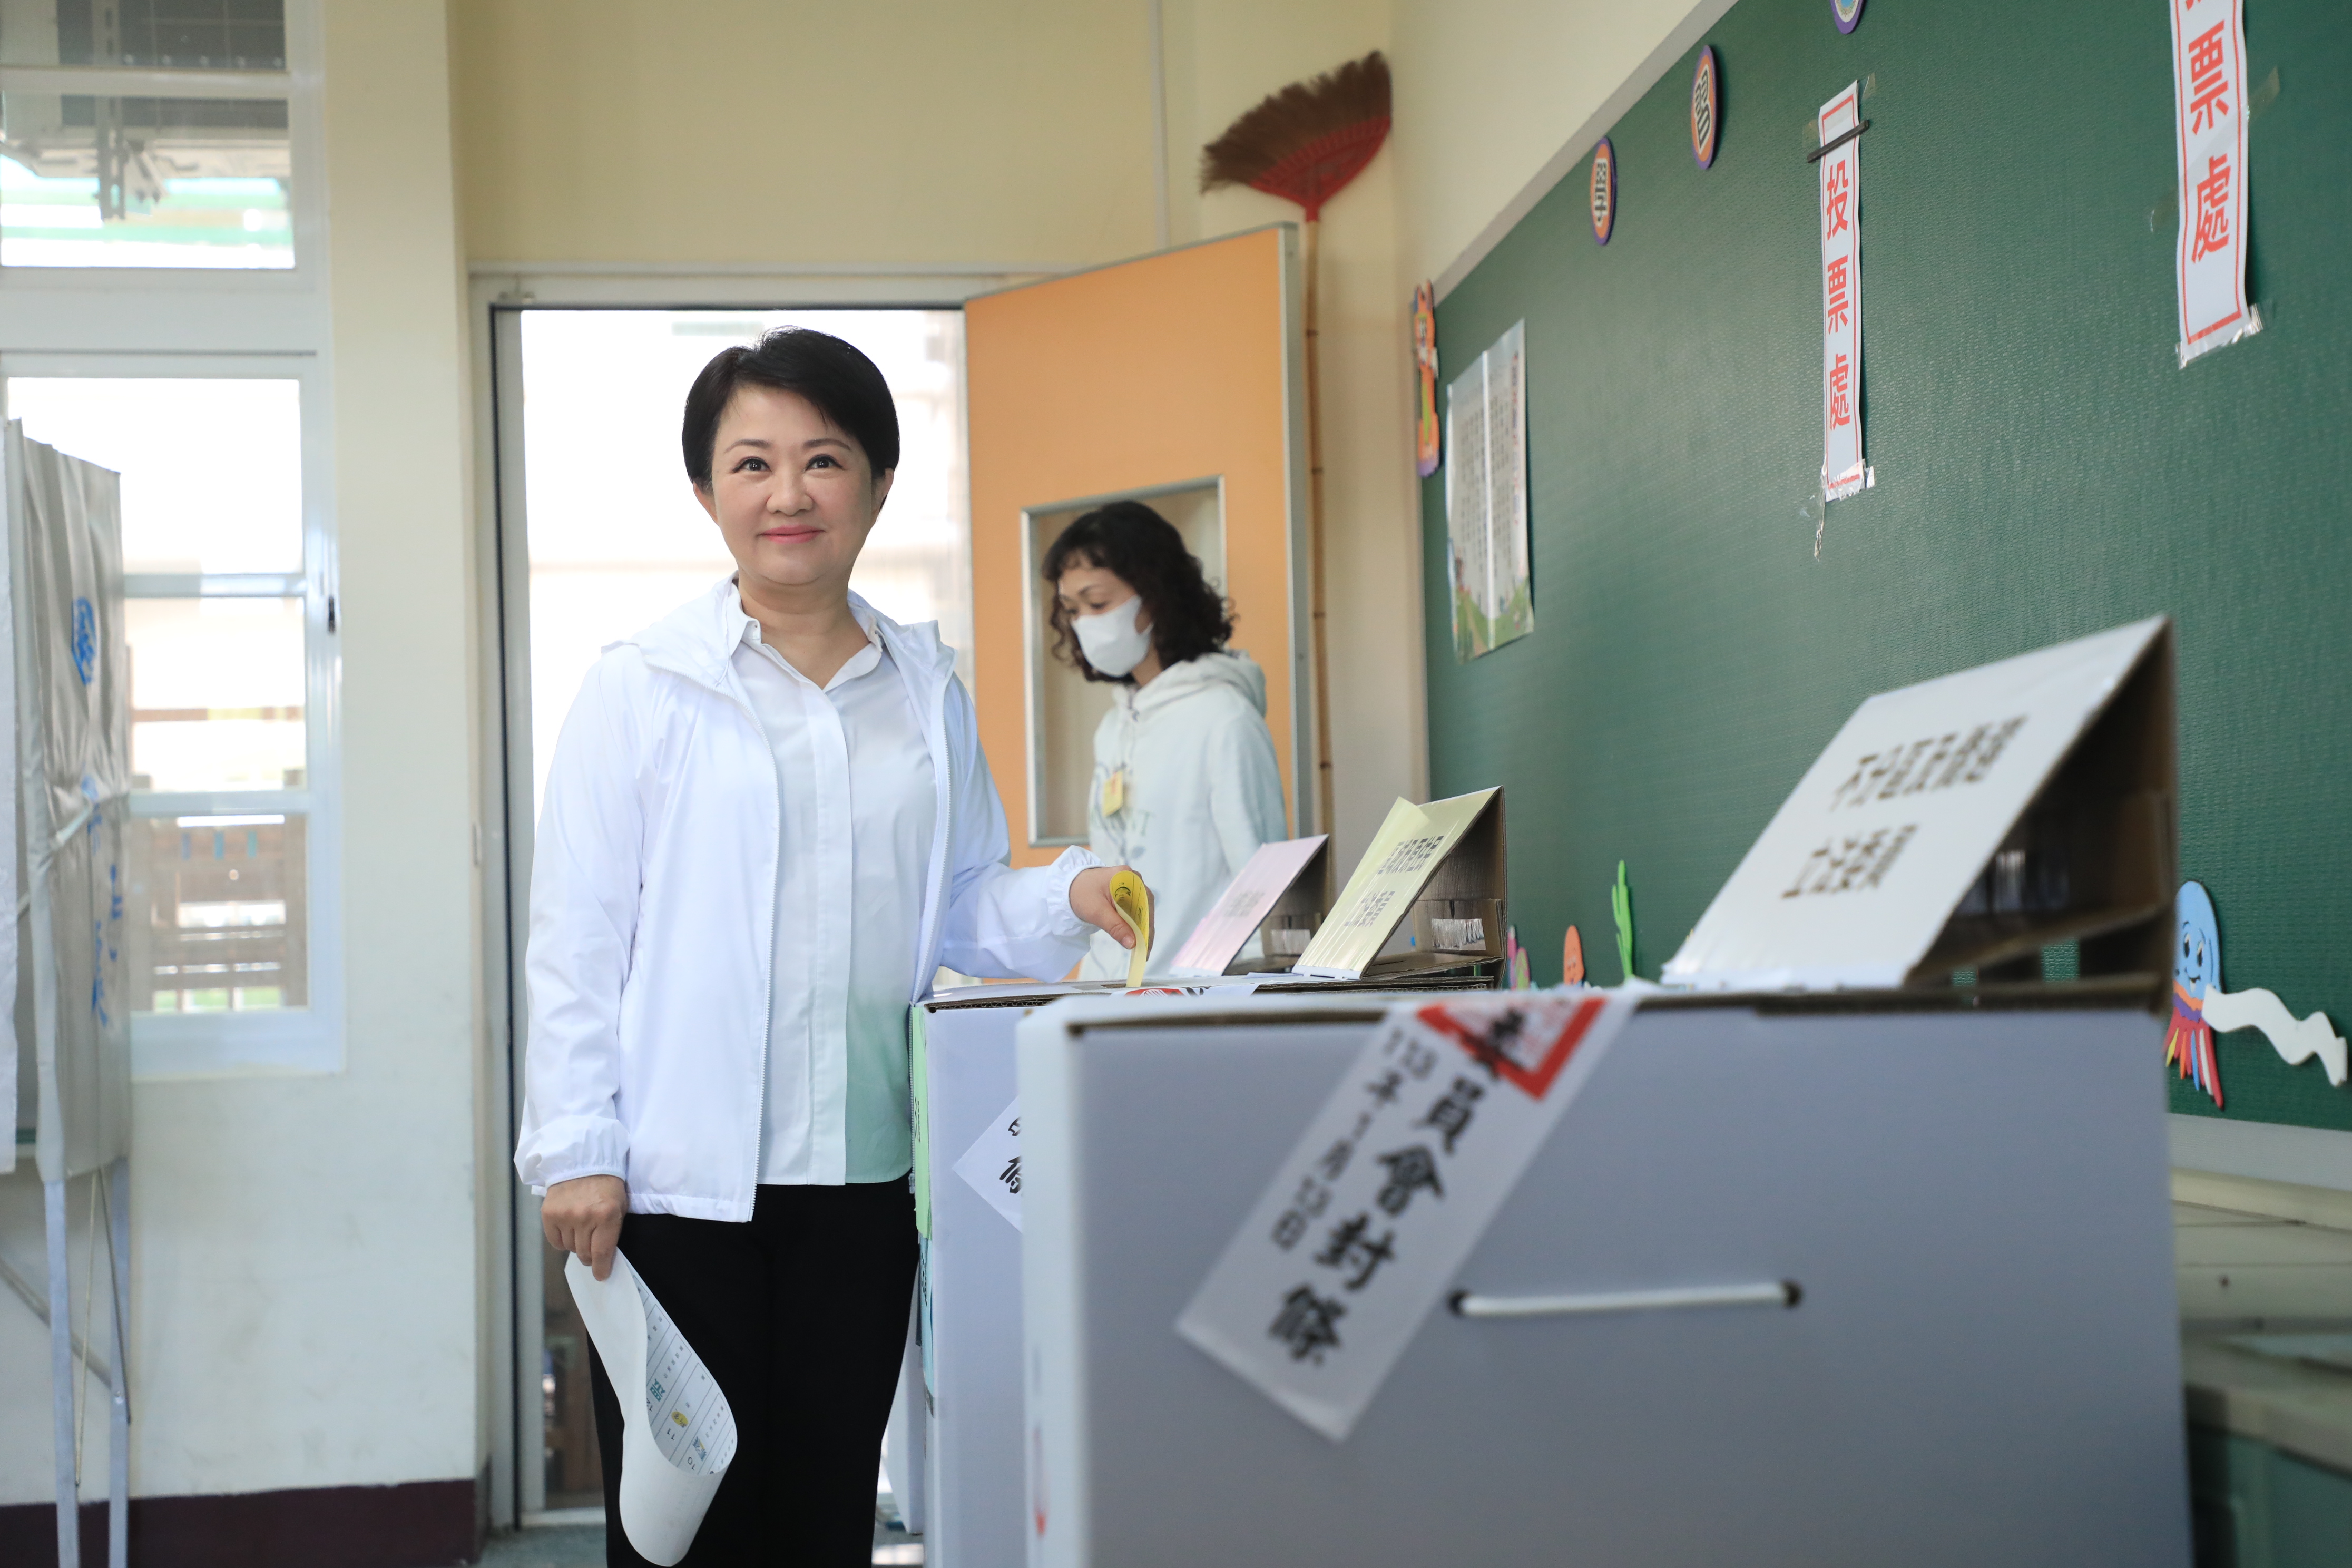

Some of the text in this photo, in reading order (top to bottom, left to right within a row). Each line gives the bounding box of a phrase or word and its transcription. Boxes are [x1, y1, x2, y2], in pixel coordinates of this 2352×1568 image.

[2186, 0, 2231, 263] 票處
[1826, 159, 1850, 430] 投票處
[1344, 890, 1396, 928] 立法委員
[667, 1428, 675, 1440] 11
[687, 1456, 695, 1471] 10
